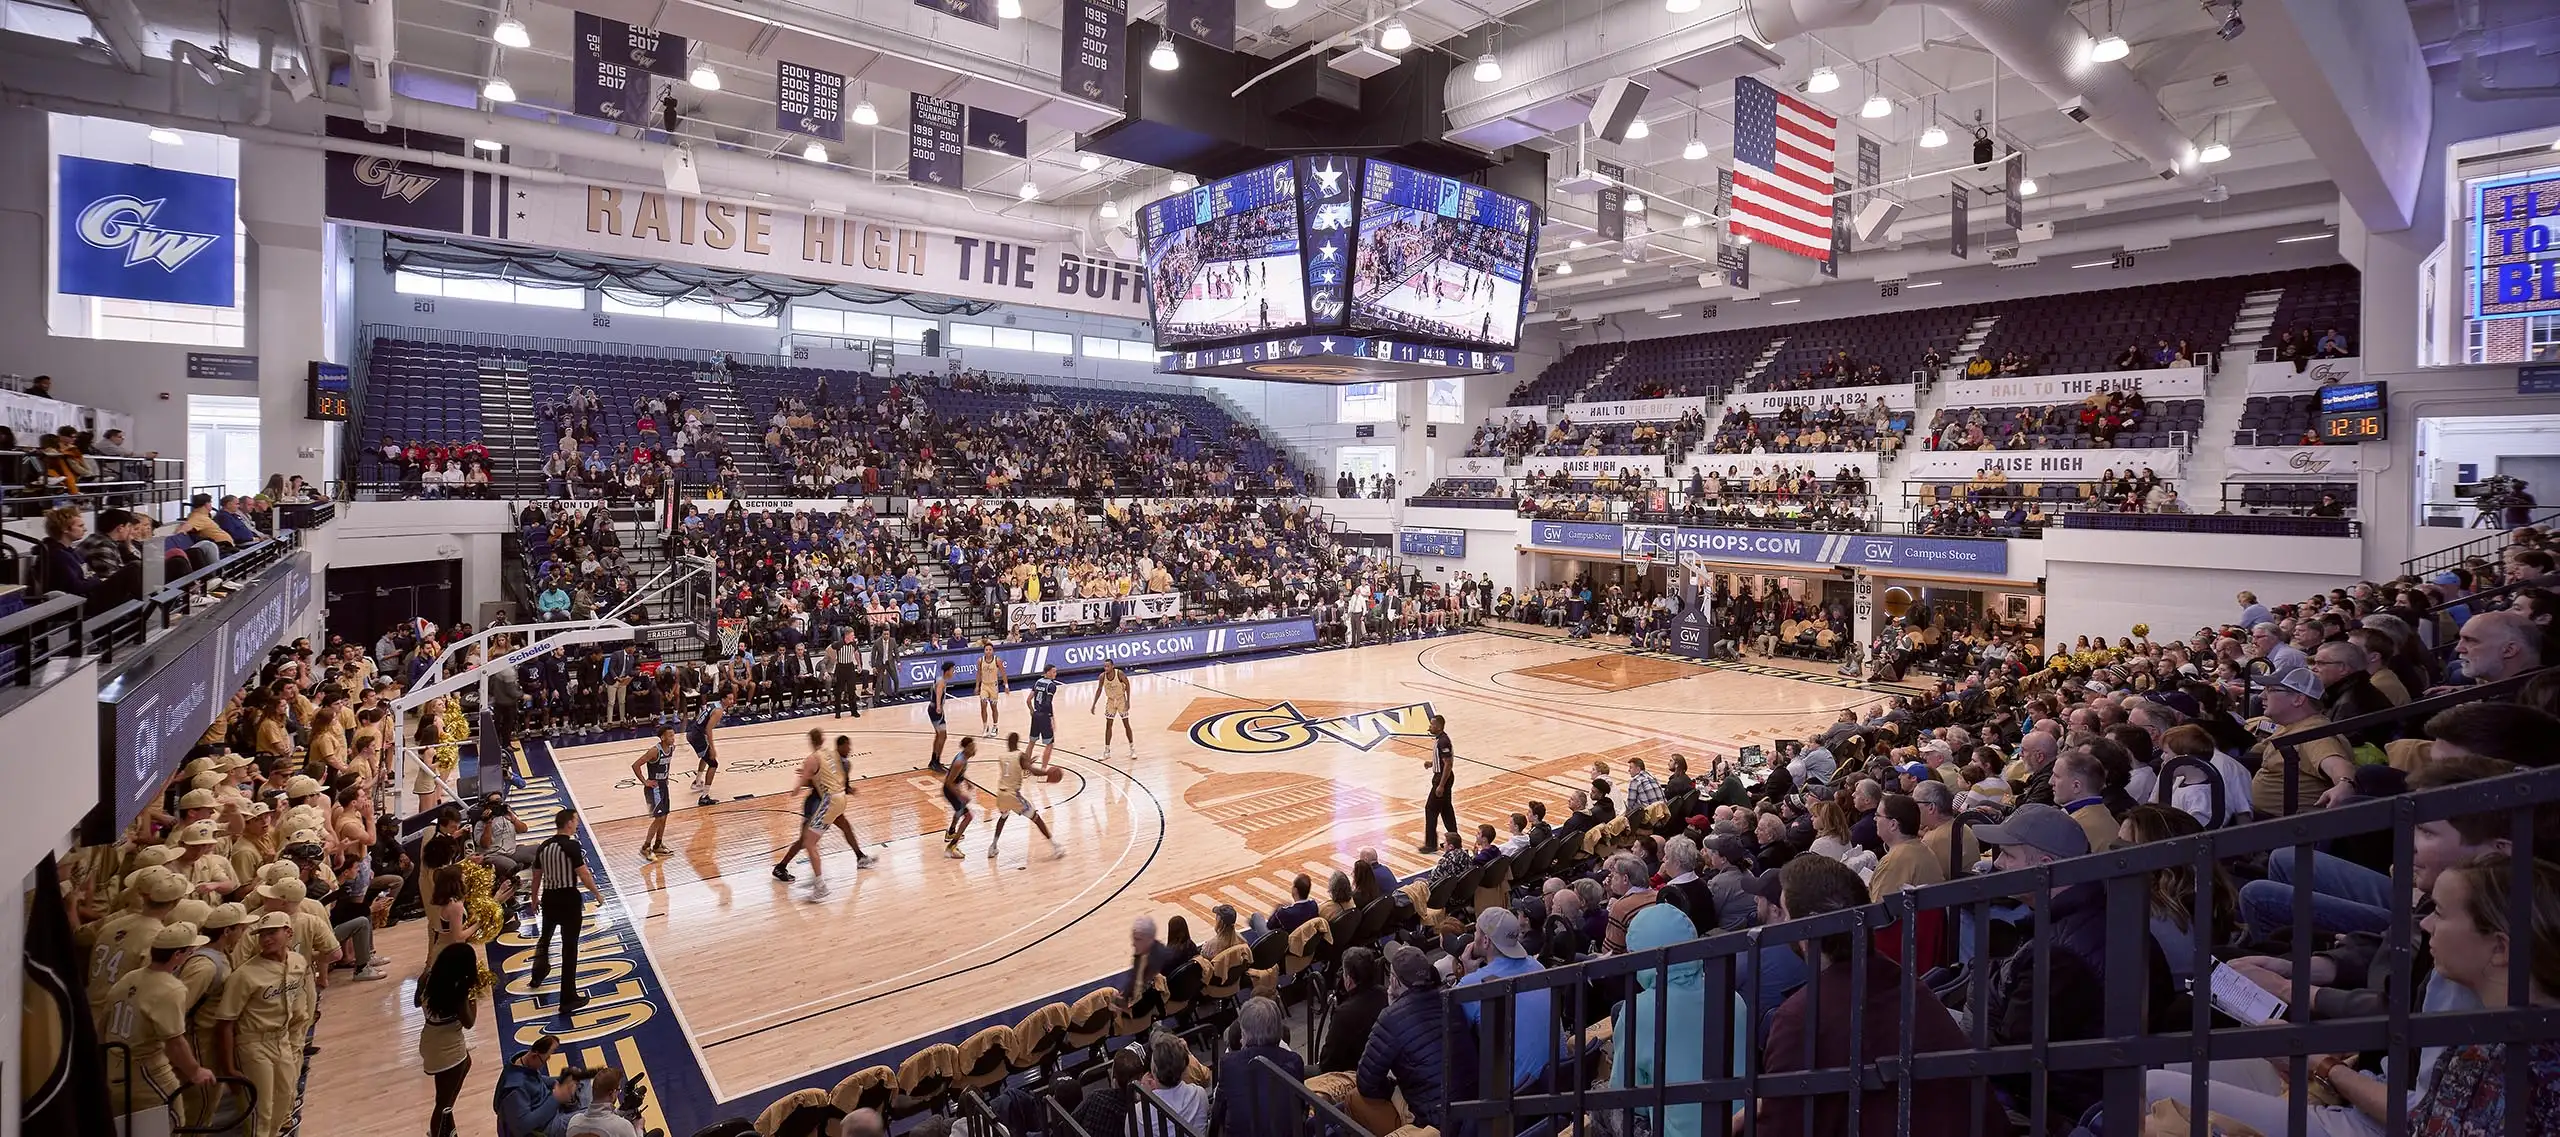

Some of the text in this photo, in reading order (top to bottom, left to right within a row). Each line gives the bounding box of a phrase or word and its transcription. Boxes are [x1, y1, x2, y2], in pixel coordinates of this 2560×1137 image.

[1084, 6, 1108, 25] 1995
[1084, 22, 1107, 39] 1997
[628, 34, 659, 52] 2017
[1082, 37, 1108, 55] 2007
[1081, 52, 1108, 70] 2008
[598, 62, 626, 78] 2015
[782, 64, 841, 87] 2004 2008
[598, 74, 626, 90] 2017
[782, 76, 838, 99] 2005 2015
[782, 88, 838, 110] 2006 2016
[918, 95, 958, 112] ATLANTIC 10
[781, 101, 838, 122] 2007 2017
[916, 102, 960, 120] TOURNAMENT
[918, 110, 956, 126] CHAMPIONS
[913, 124, 959, 143] 1998 2001
[912, 148, 936, 160] 2000
[913, 136, 961, 155] 1999 2002
[586, 184, 774, 256] RAISE
[802, 214, 928, 276] HIGH
[954, 236, 1036, 290] THE
[2496, 224, 2549, 256] TO
[2112, 256, 2134, 268] 210
[1881, 287, 1898, 297] 209
[414, 302, 435, 313] 201
[1703, 310, 1716, 318] 208
[593, 318, 610, 328] 202
[794, 351, 809, 360] 203
[1204, 352, 1214, 365] 11
[1222, 348, 1241, 360] 14:19
[1254, 346, 1260, 360] 5
[1382, 342, 1388, 351] 4
[1402, 346, 1413, 360] 11
[1423, 348, 1444, 360] 14:19
[1458, 352, 1464, 366] 5
[1992, 377, 2143, 398] HAIL TO THE BLUE
[319, 397, 346, 416] 12:16
[1763, 392, 1868, 408] FOUNDED IN 1821
[1590, 403, 1673, 417] HAIL TO THE BUFF
[2332, 416, 2378, 437] 12:16
[1563, 461, 1616, 472] RAISE HIGH
[1984, 457, 2084, 471] RAISE HIGH
[1544, 527, 1612, 541] GW Campus Store
[1407, 543, 1412, 551] 11
[1450, 546, 1454, 554] 5
[1660, 532, 1800, 554] GWSHOPS.COM
[1865, 544, 1977, 561] GW Campus Store
[1668, 570, 1680, 578] 106
[1856, 584, 1871, 594] 108
[1104, 600, 1136, 617] AMY
[1855, 605, 1871, 614] 107
[1680, 630, 1700, 641] GW
[508, 642, 551, 664] Schelde
[1064, 628, 1301, 664] GWSHOPS.COM GW Campus Store
[910, 664, 937, 681] GW
[1187, 700, 1437, 754] GW
[111, 1001, 134, 1040] 10
